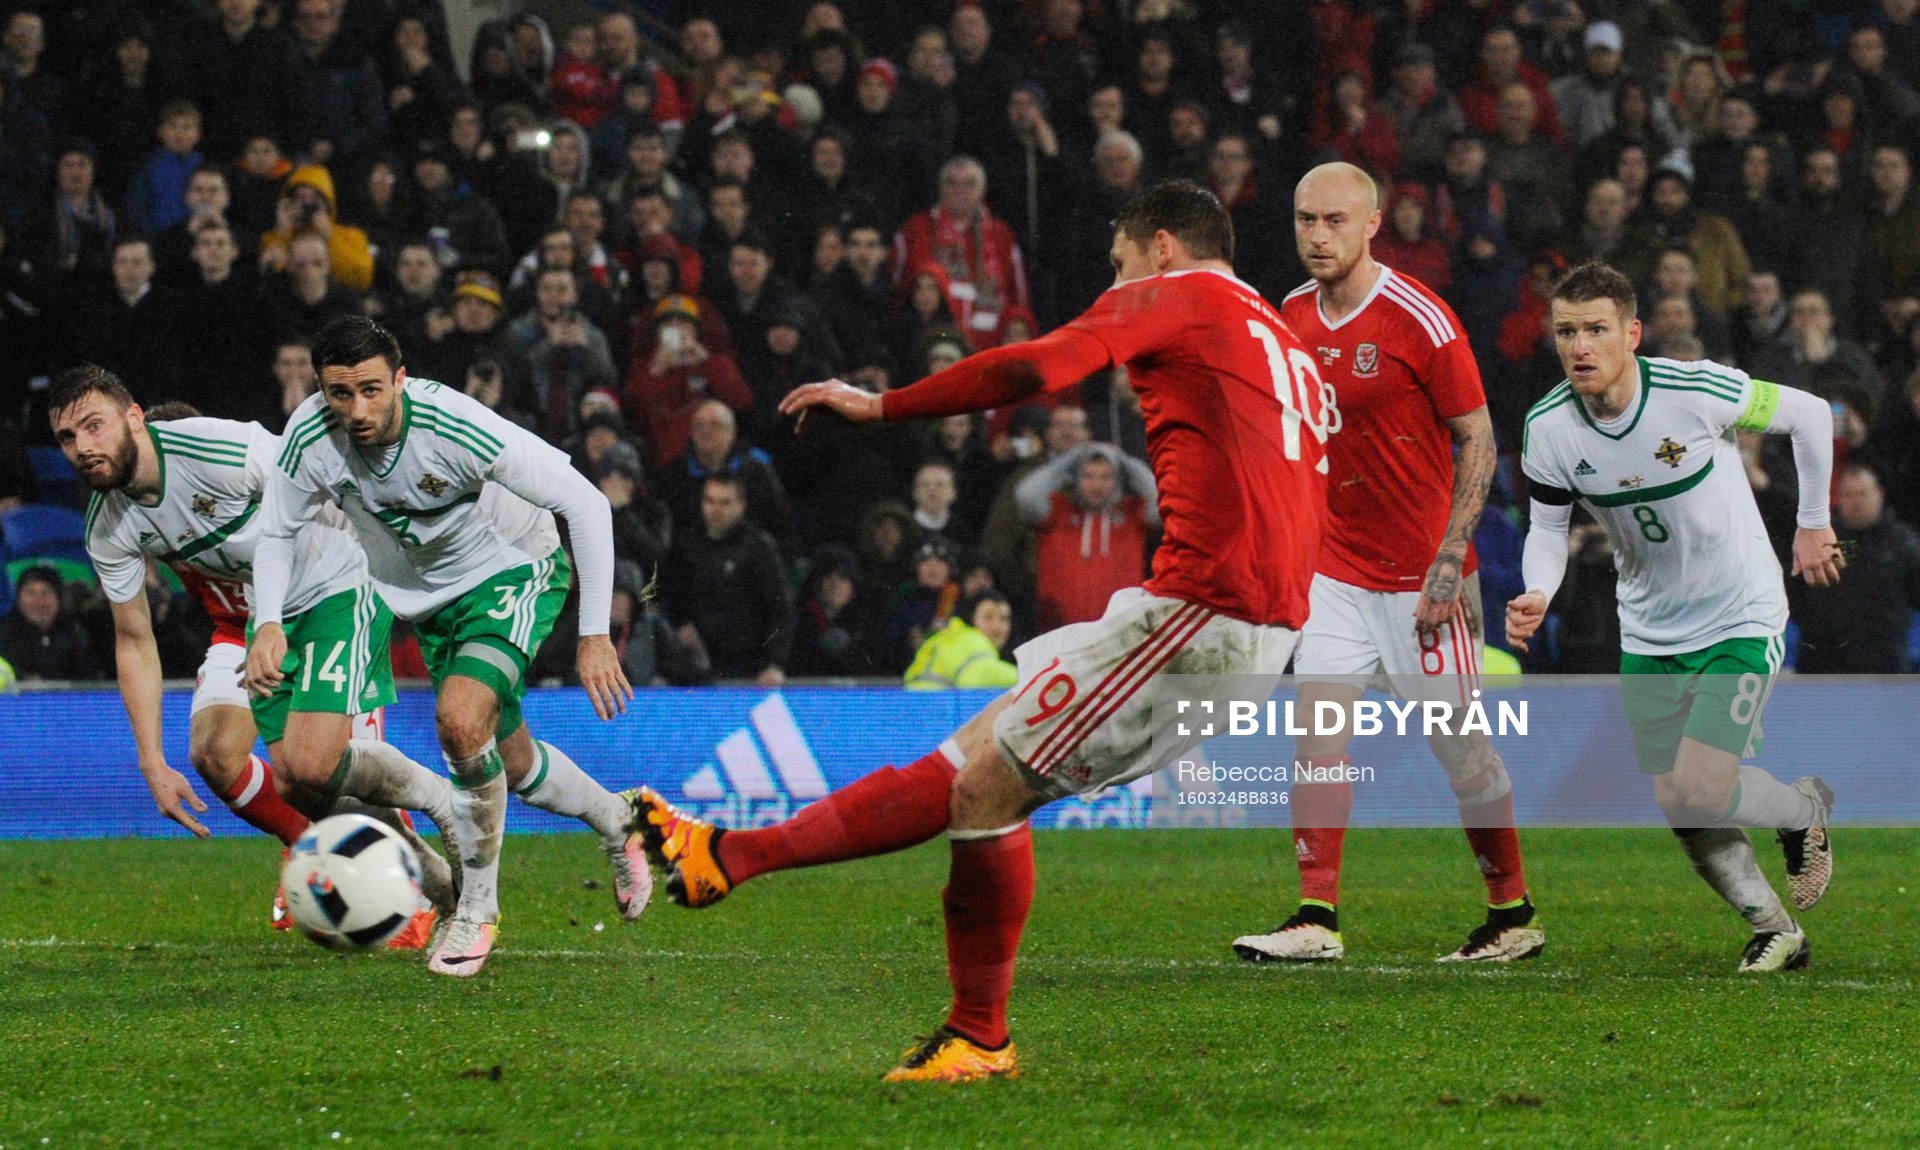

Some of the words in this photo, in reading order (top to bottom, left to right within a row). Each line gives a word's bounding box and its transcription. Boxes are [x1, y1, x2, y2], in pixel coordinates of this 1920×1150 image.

[1632, 504, 1669, 543] 8
[487, 586, 518, 620] 3
[301, 640, 347, 692] 14
[1418, 620, 1444, 677] 8
[1012, 656, 1077, 727] 19
[1730, 672, 1763, 725] 8
